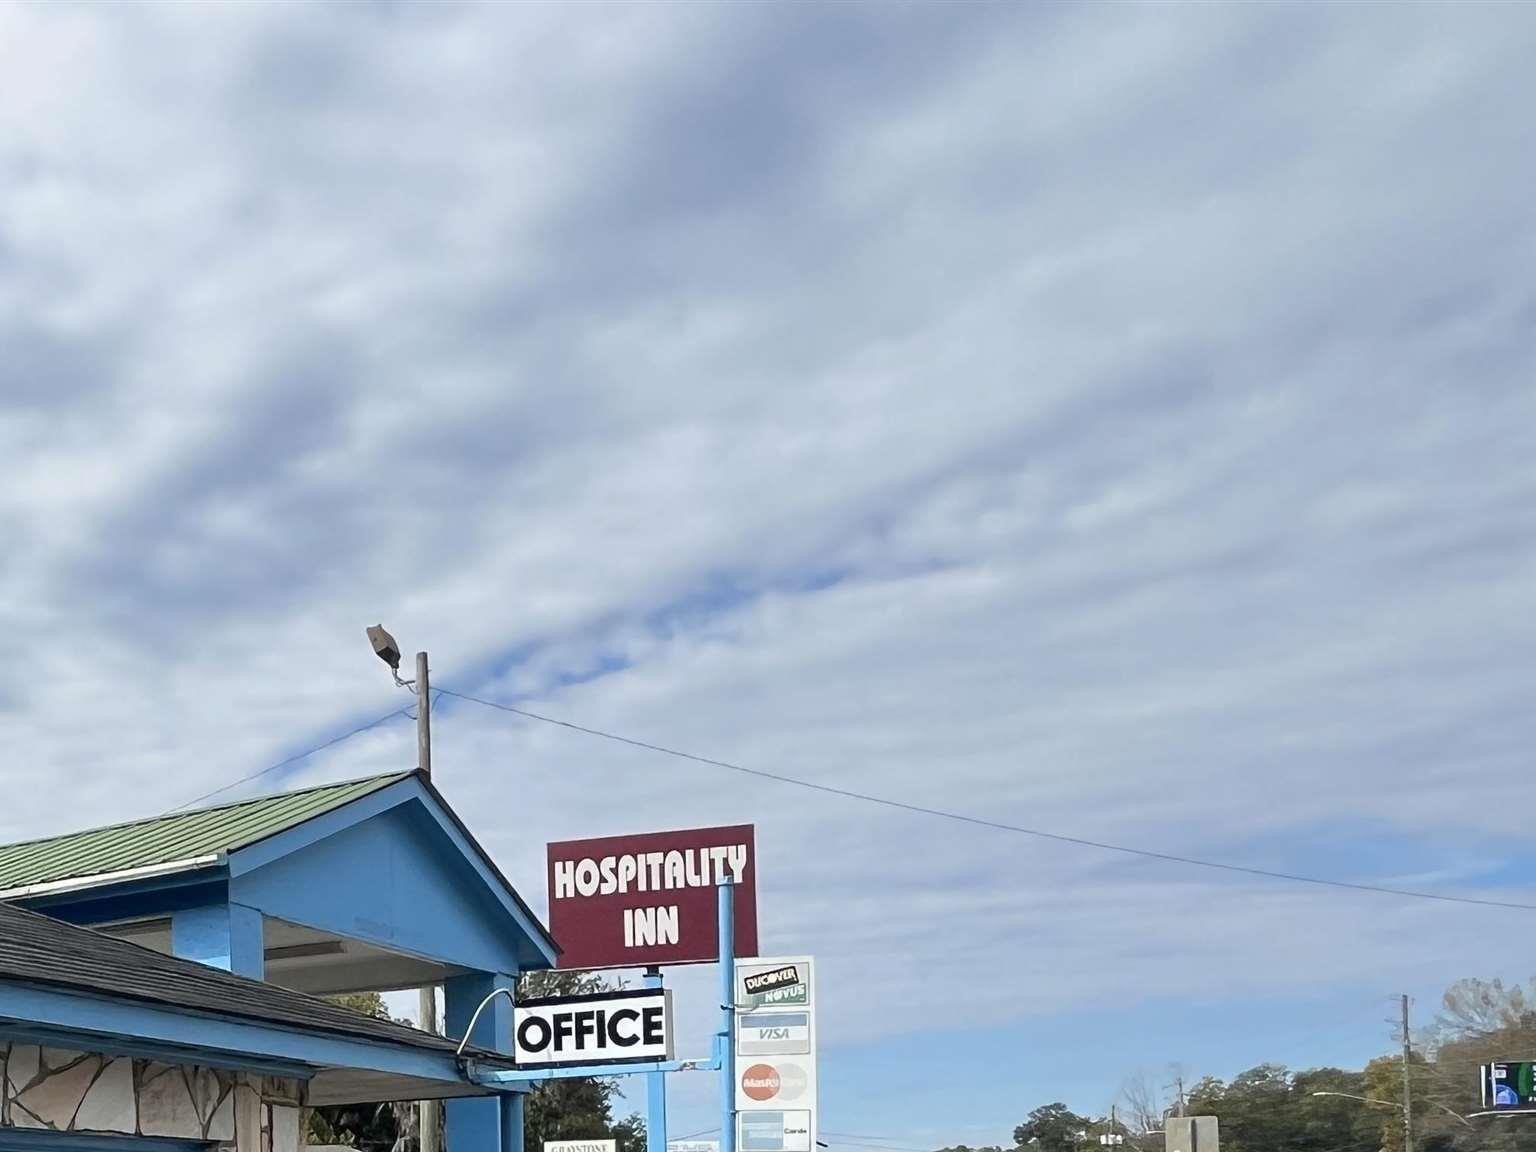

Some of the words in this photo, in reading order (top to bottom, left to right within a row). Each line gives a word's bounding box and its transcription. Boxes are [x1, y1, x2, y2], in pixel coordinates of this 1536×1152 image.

[554, 844, 748, 899] HOSPITALITY
[623, 905, 680, 948] INN
[516, 1006, 664, 1053] OFFICE
[759, 1028, 790, 1040] VISA
